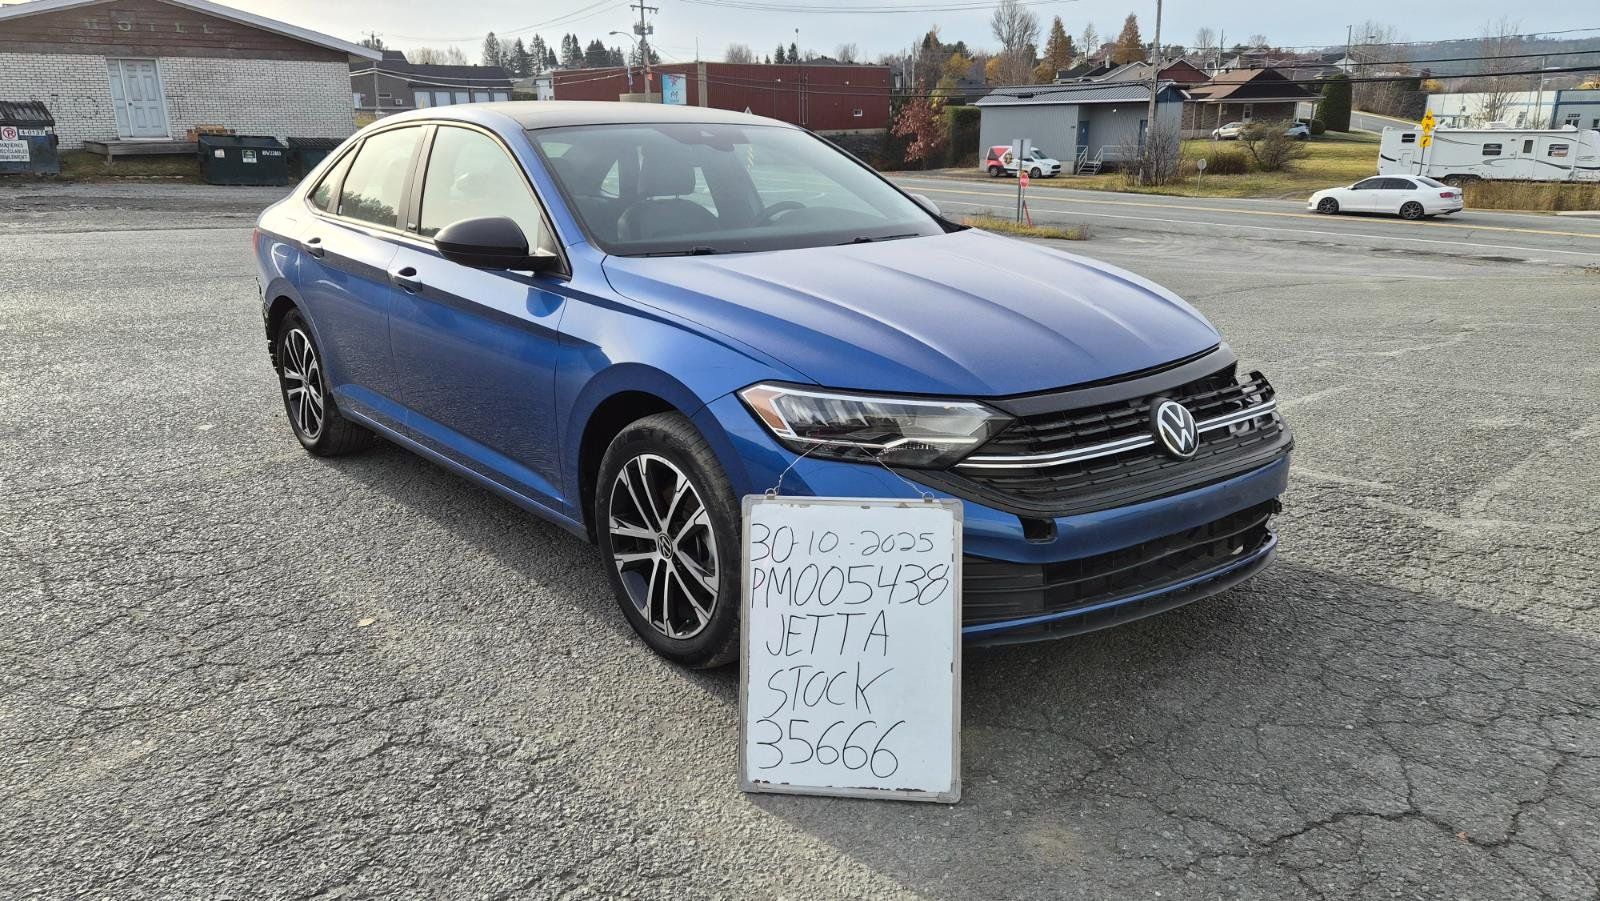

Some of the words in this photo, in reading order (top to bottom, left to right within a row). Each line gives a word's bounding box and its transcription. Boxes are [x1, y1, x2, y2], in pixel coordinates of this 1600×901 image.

[751, 563, 950, 609] PM005438
[766, 609, 889, 656] JETTA
[762, 661, 895, 718] STOCK
[756, 719, 906, 778] 35666
